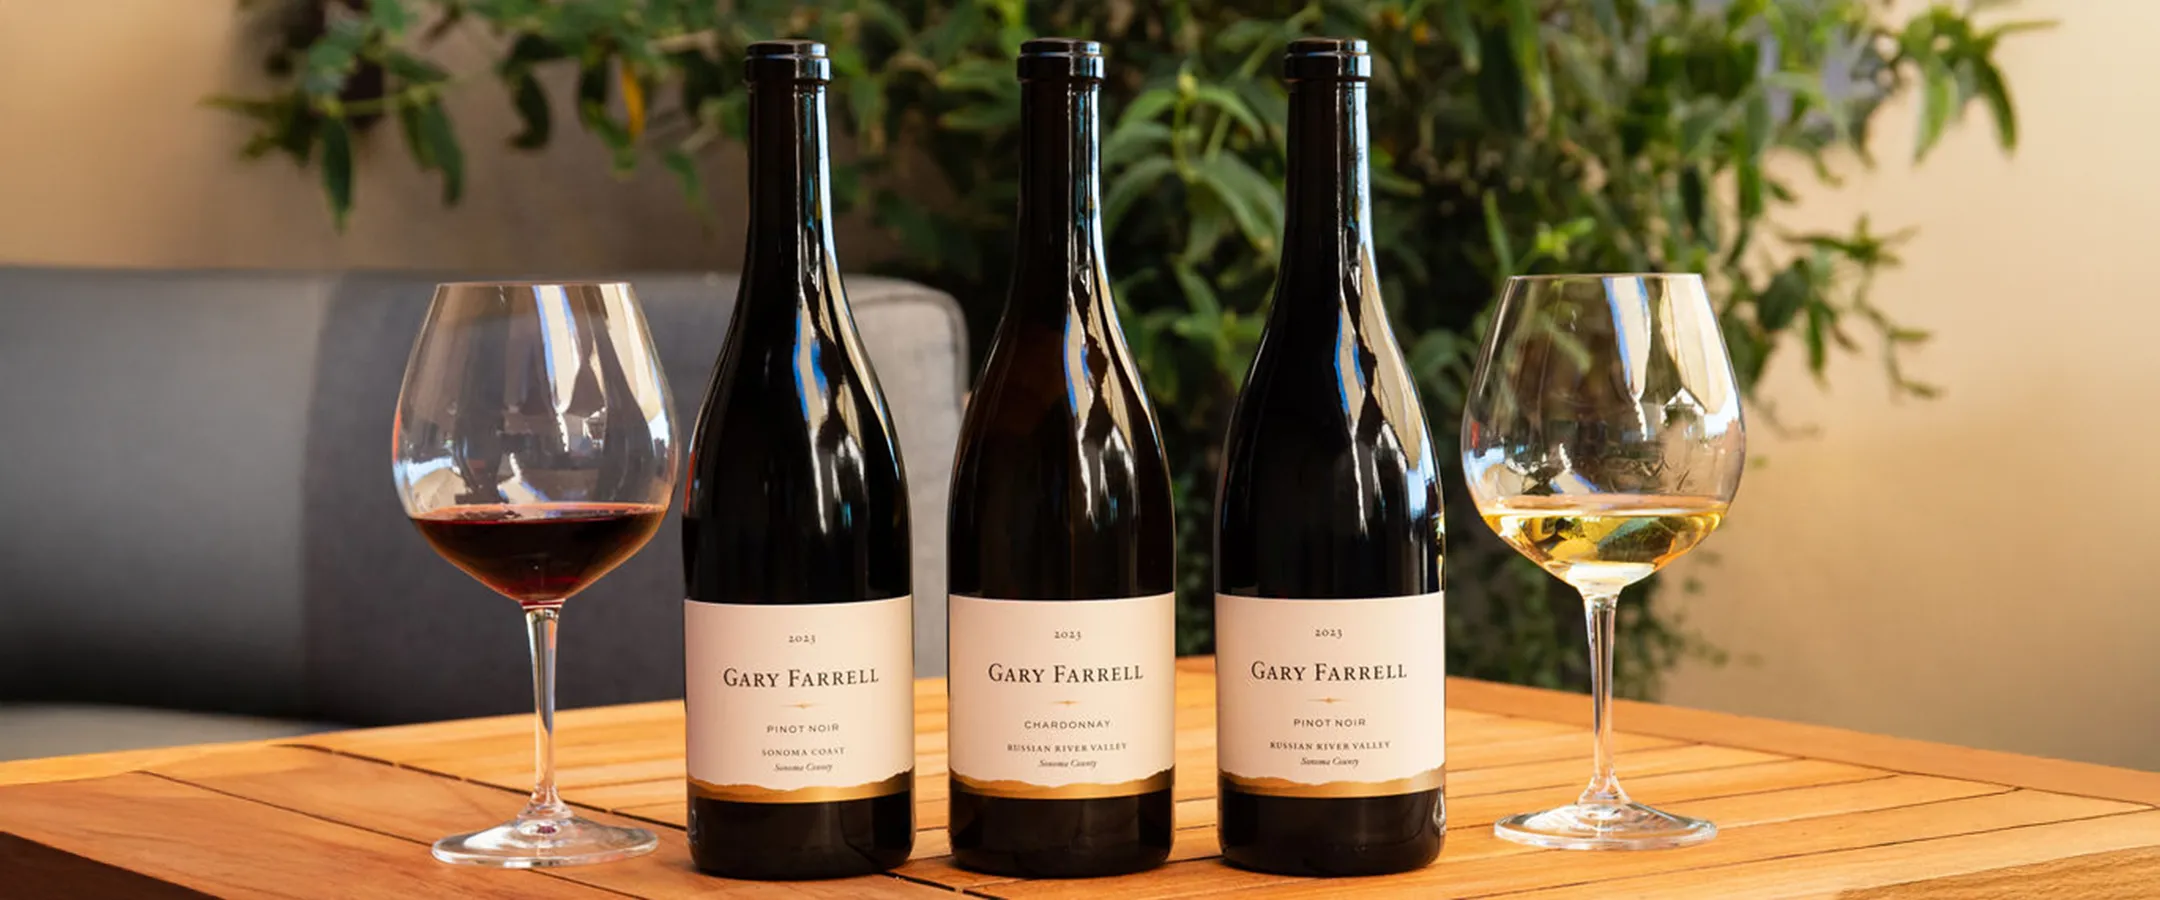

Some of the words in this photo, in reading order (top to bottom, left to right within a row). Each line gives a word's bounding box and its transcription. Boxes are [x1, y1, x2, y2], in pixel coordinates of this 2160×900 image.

[1054, 631, 1081, 640] 2023
[1315, 628, 1343, 638] 2023
[789, 635, 816, 644] 2023
[988, 663, 1044, 683] GARY
[1054, 665, 1143, 683] FARRELL
[1251, 661, 1307, 681] GARY
[1315, 663, 1407, 681] FARRELL
[724, 668, 779, 687] GARY
[789, 669, 879, 687] FARRELL
[1024, 720, 1111, 729] CHARDONNAY
[1294, 719, 1331, 727] PINOT
[1335, 718, 1366, 727] NOIR
[767, 725, 804, 733] PINOT
[809, 723, 839, 733] NOIR
[1007, 744, 1050, 752] RUSSIAN
[1055, 744, 1087, 752] RIVER
[1091, 742, 1127, 751] VALLEY
[1270, 741, 1312, 750] RUSSIAN
[1317, 742, 1349, 750] RIVER
[1353, 740, 1391, 749] VALLEY
[811, 747, 845, 756] COAST
[1301, 757, 1330, 766] Sonoma
[774, 763, 803, 771] Sonoma
